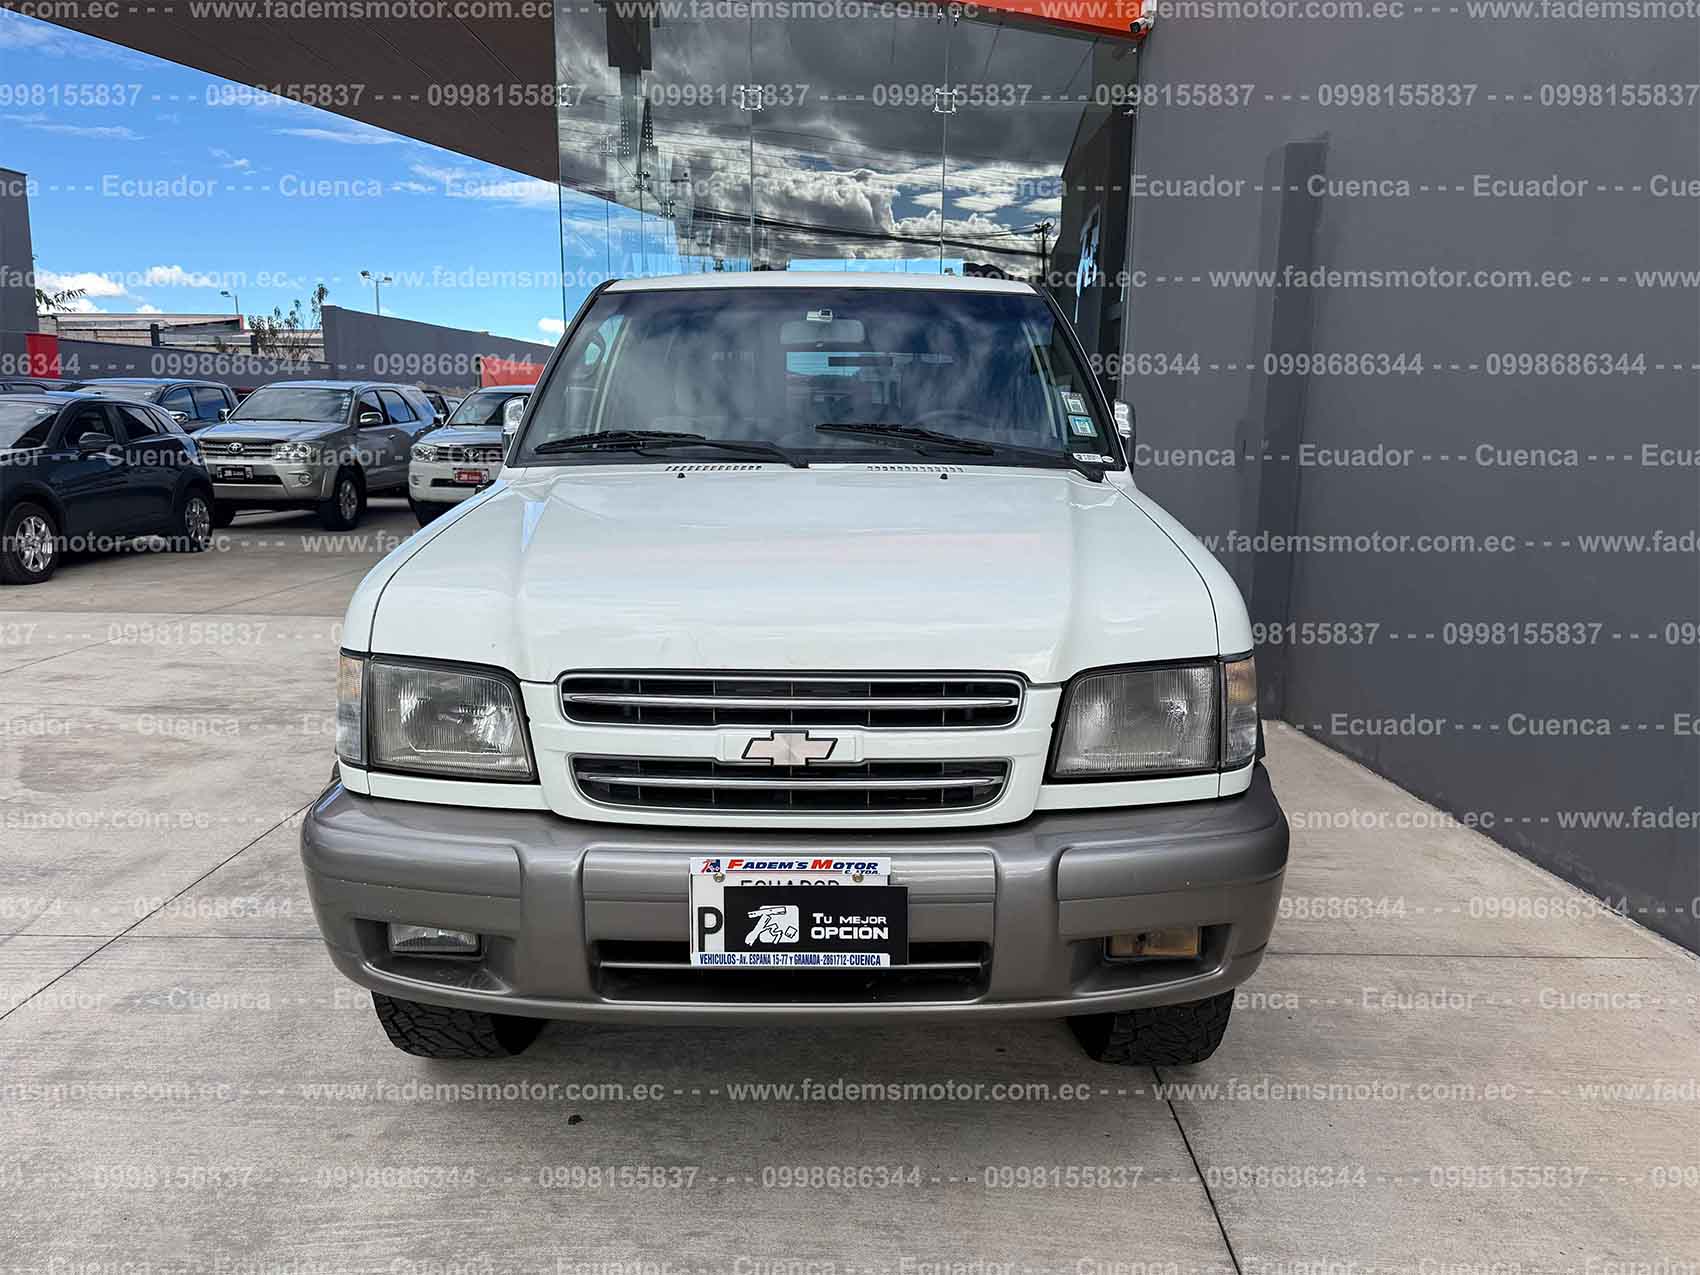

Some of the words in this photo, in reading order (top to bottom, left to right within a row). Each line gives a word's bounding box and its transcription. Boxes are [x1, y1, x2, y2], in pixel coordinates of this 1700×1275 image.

[810, 859, 879, 870] MOTOR
[839, 916, 887, 924] MEJOR
[810, 925, 889, 940] OPCIÓN
